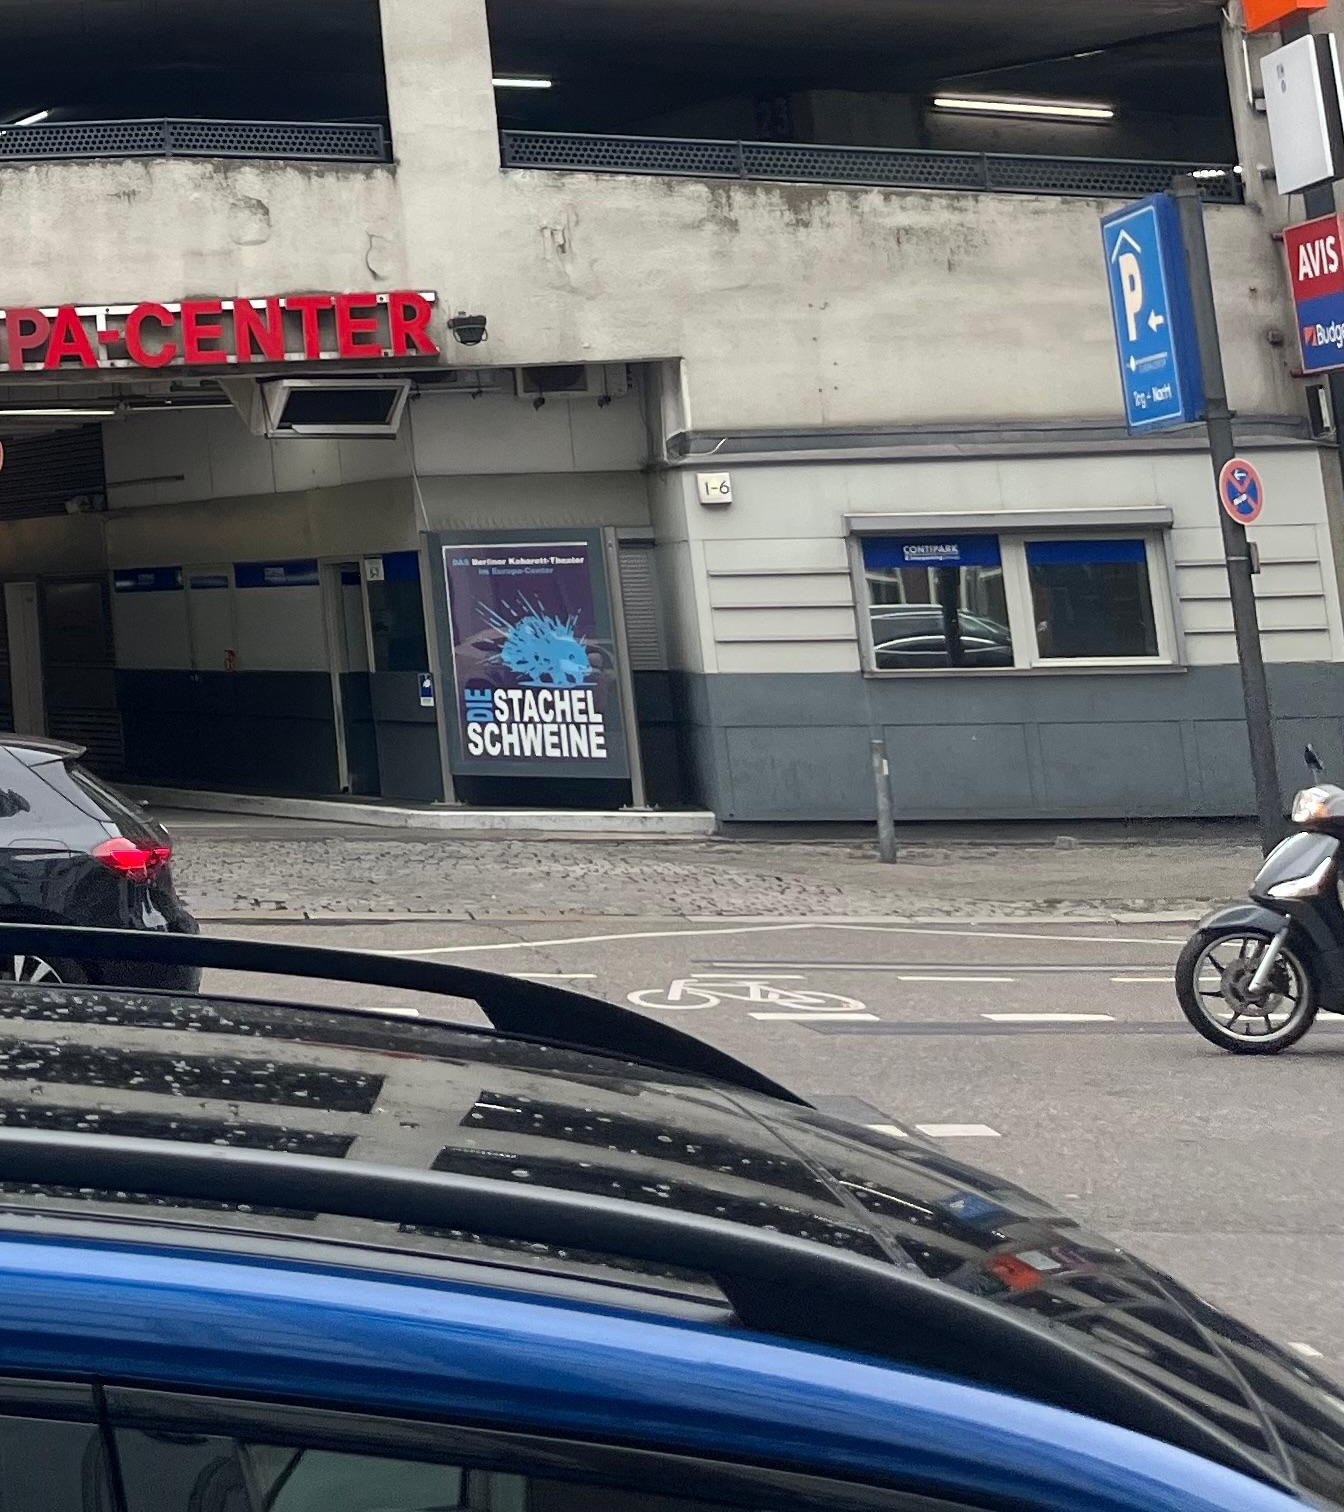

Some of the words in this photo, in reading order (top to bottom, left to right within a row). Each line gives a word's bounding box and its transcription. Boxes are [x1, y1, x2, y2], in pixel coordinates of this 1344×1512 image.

[1299, 236, 1339, 281] AVIS
[1118, 253, 1143, 341] P
[903, 544, 959, 555] CONTIPARK
[464, 688, 494, 723] DIE
[494, 689, 603, 723] STACHEL
[466, 723, 608, 759] SCHWEINE
